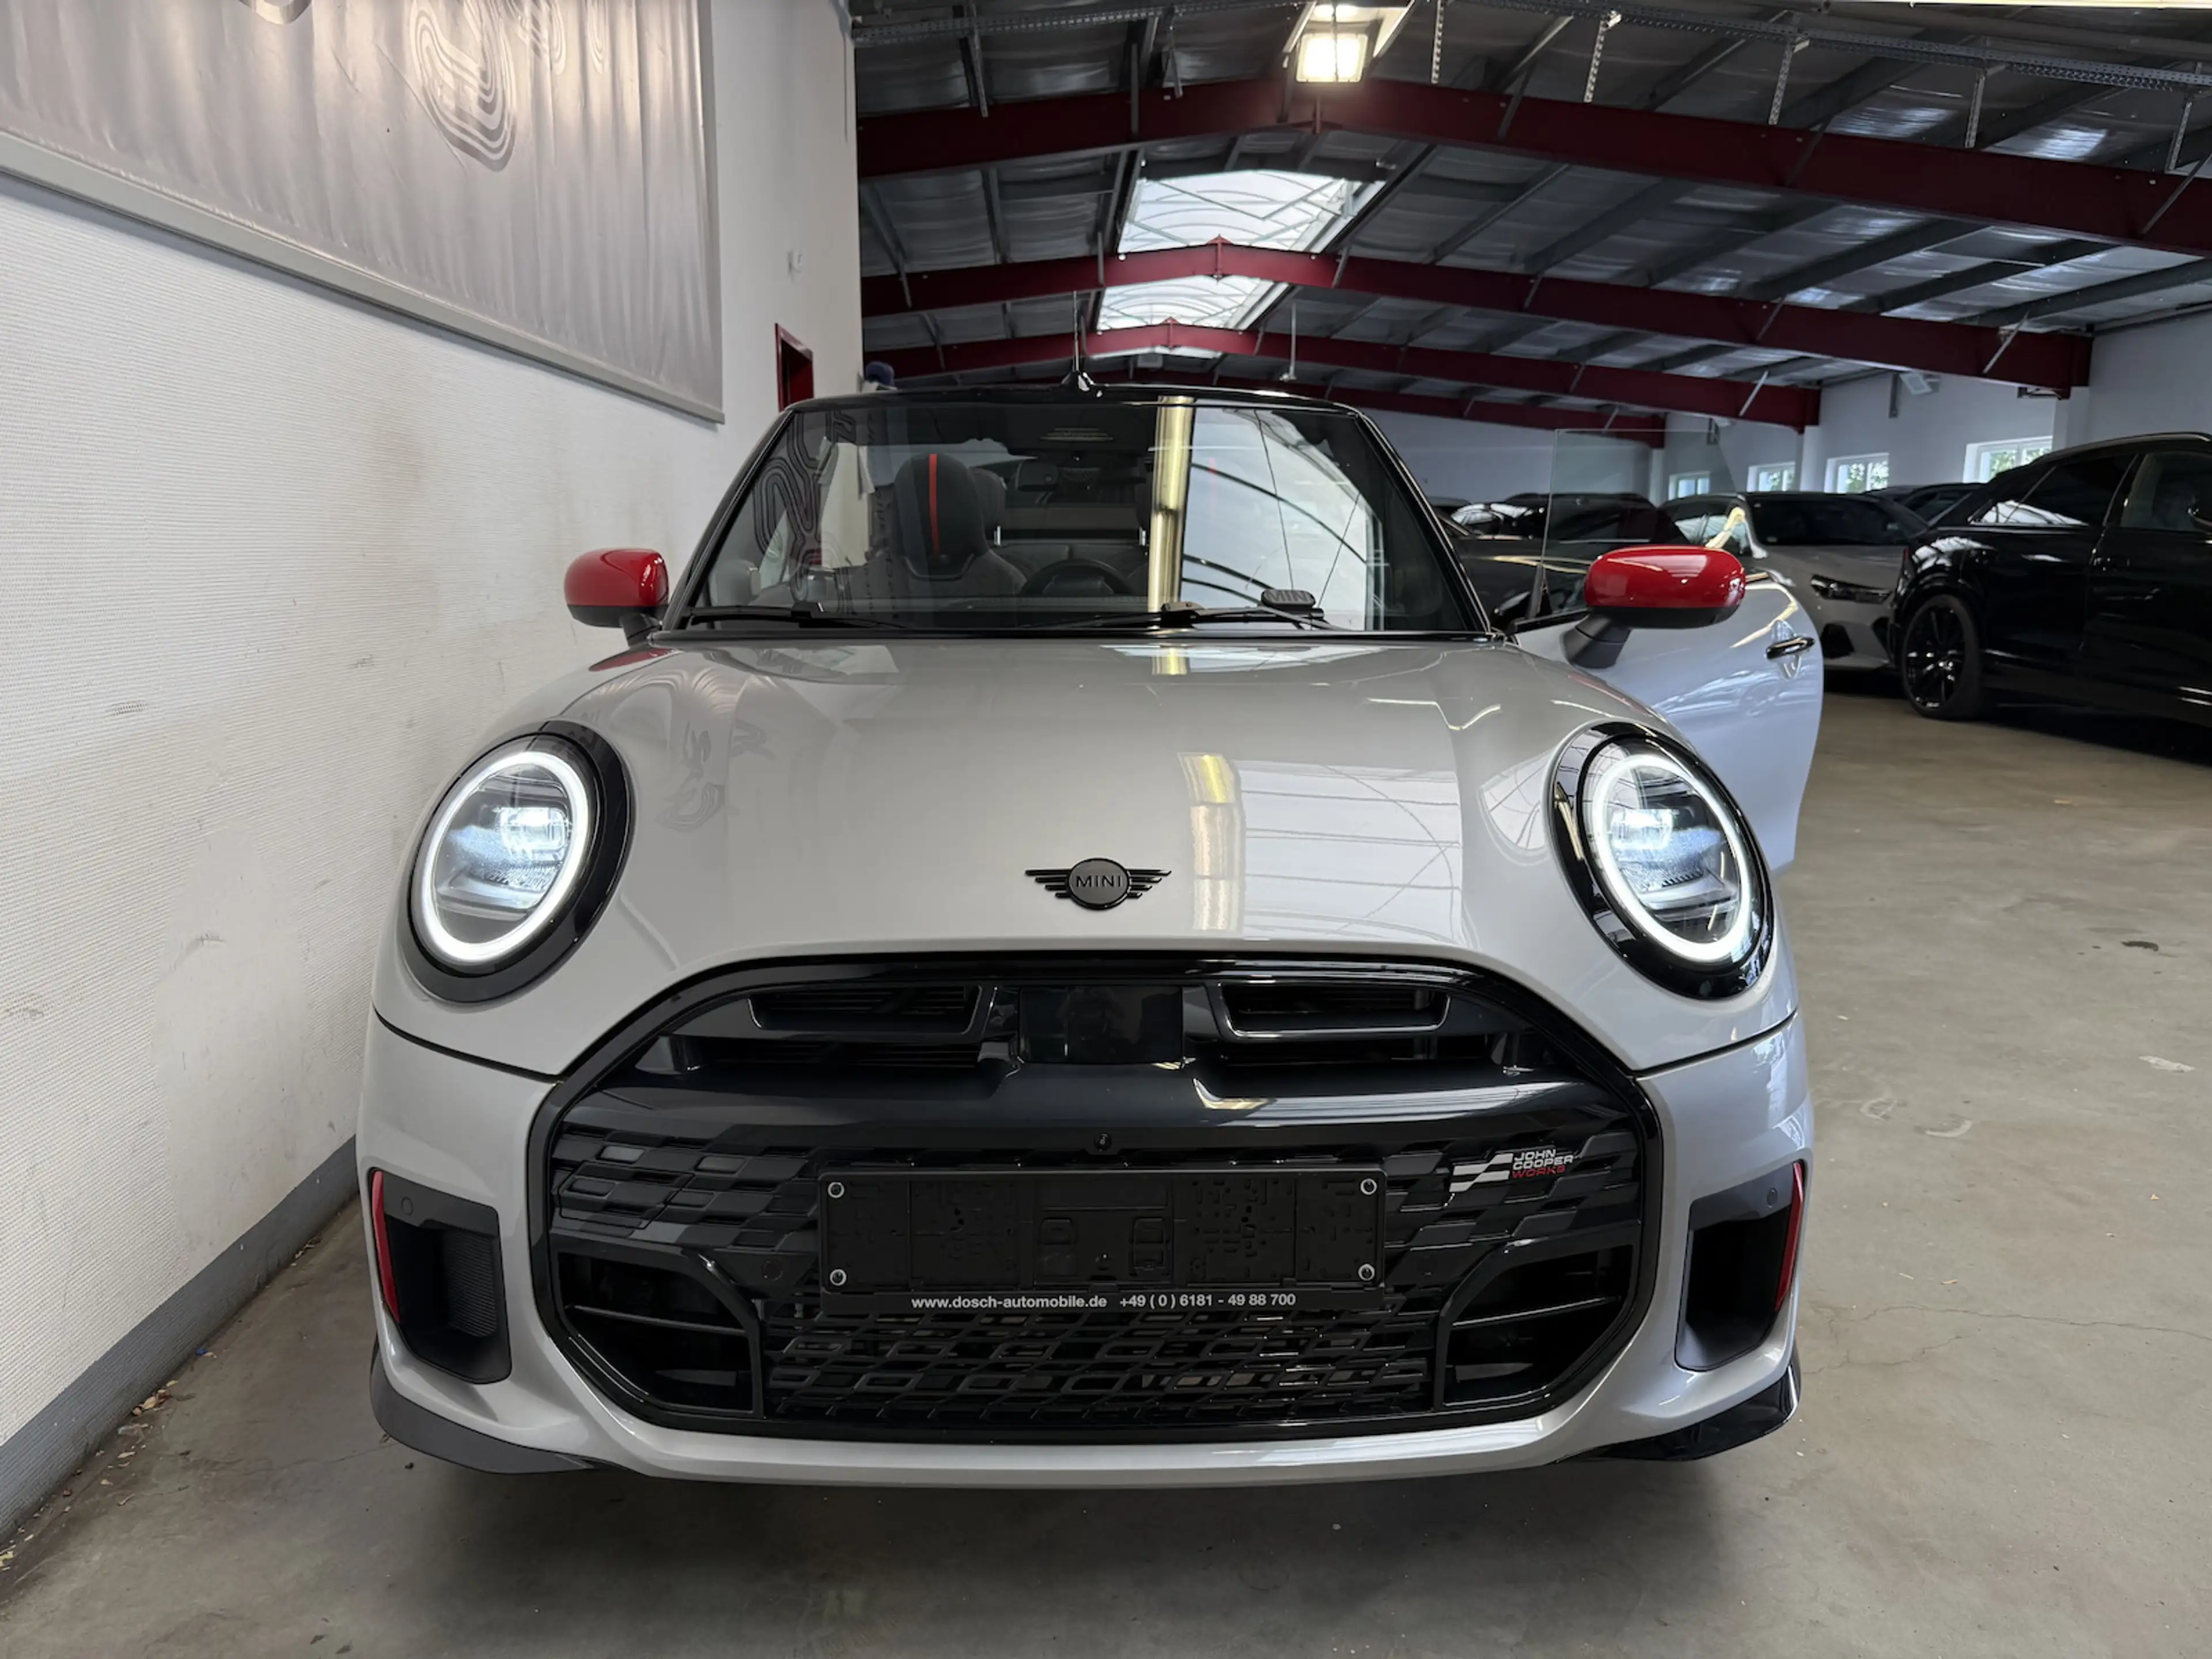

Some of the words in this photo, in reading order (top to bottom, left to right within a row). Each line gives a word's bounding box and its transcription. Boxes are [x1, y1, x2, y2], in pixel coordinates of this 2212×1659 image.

[1076, 874, 1122, 888] MINI
[1513, 1154, 1574, 1171] COOPER
[1514, 1149, 1556, 1162] JOHN
[1512, 1164, 1566, 1179] WORKS
[911, 1294, 1107, 1308] www.dosch-automobile.de
[1119, 1294, 1146, 1307] +49
[1179, 1293, 1212, 1306] 6181
[1227, 1293, 1245, 1306] 49
[1248, 1293, 1267, 1306] 88
[1270, 1293, 1296, 1305] 700
